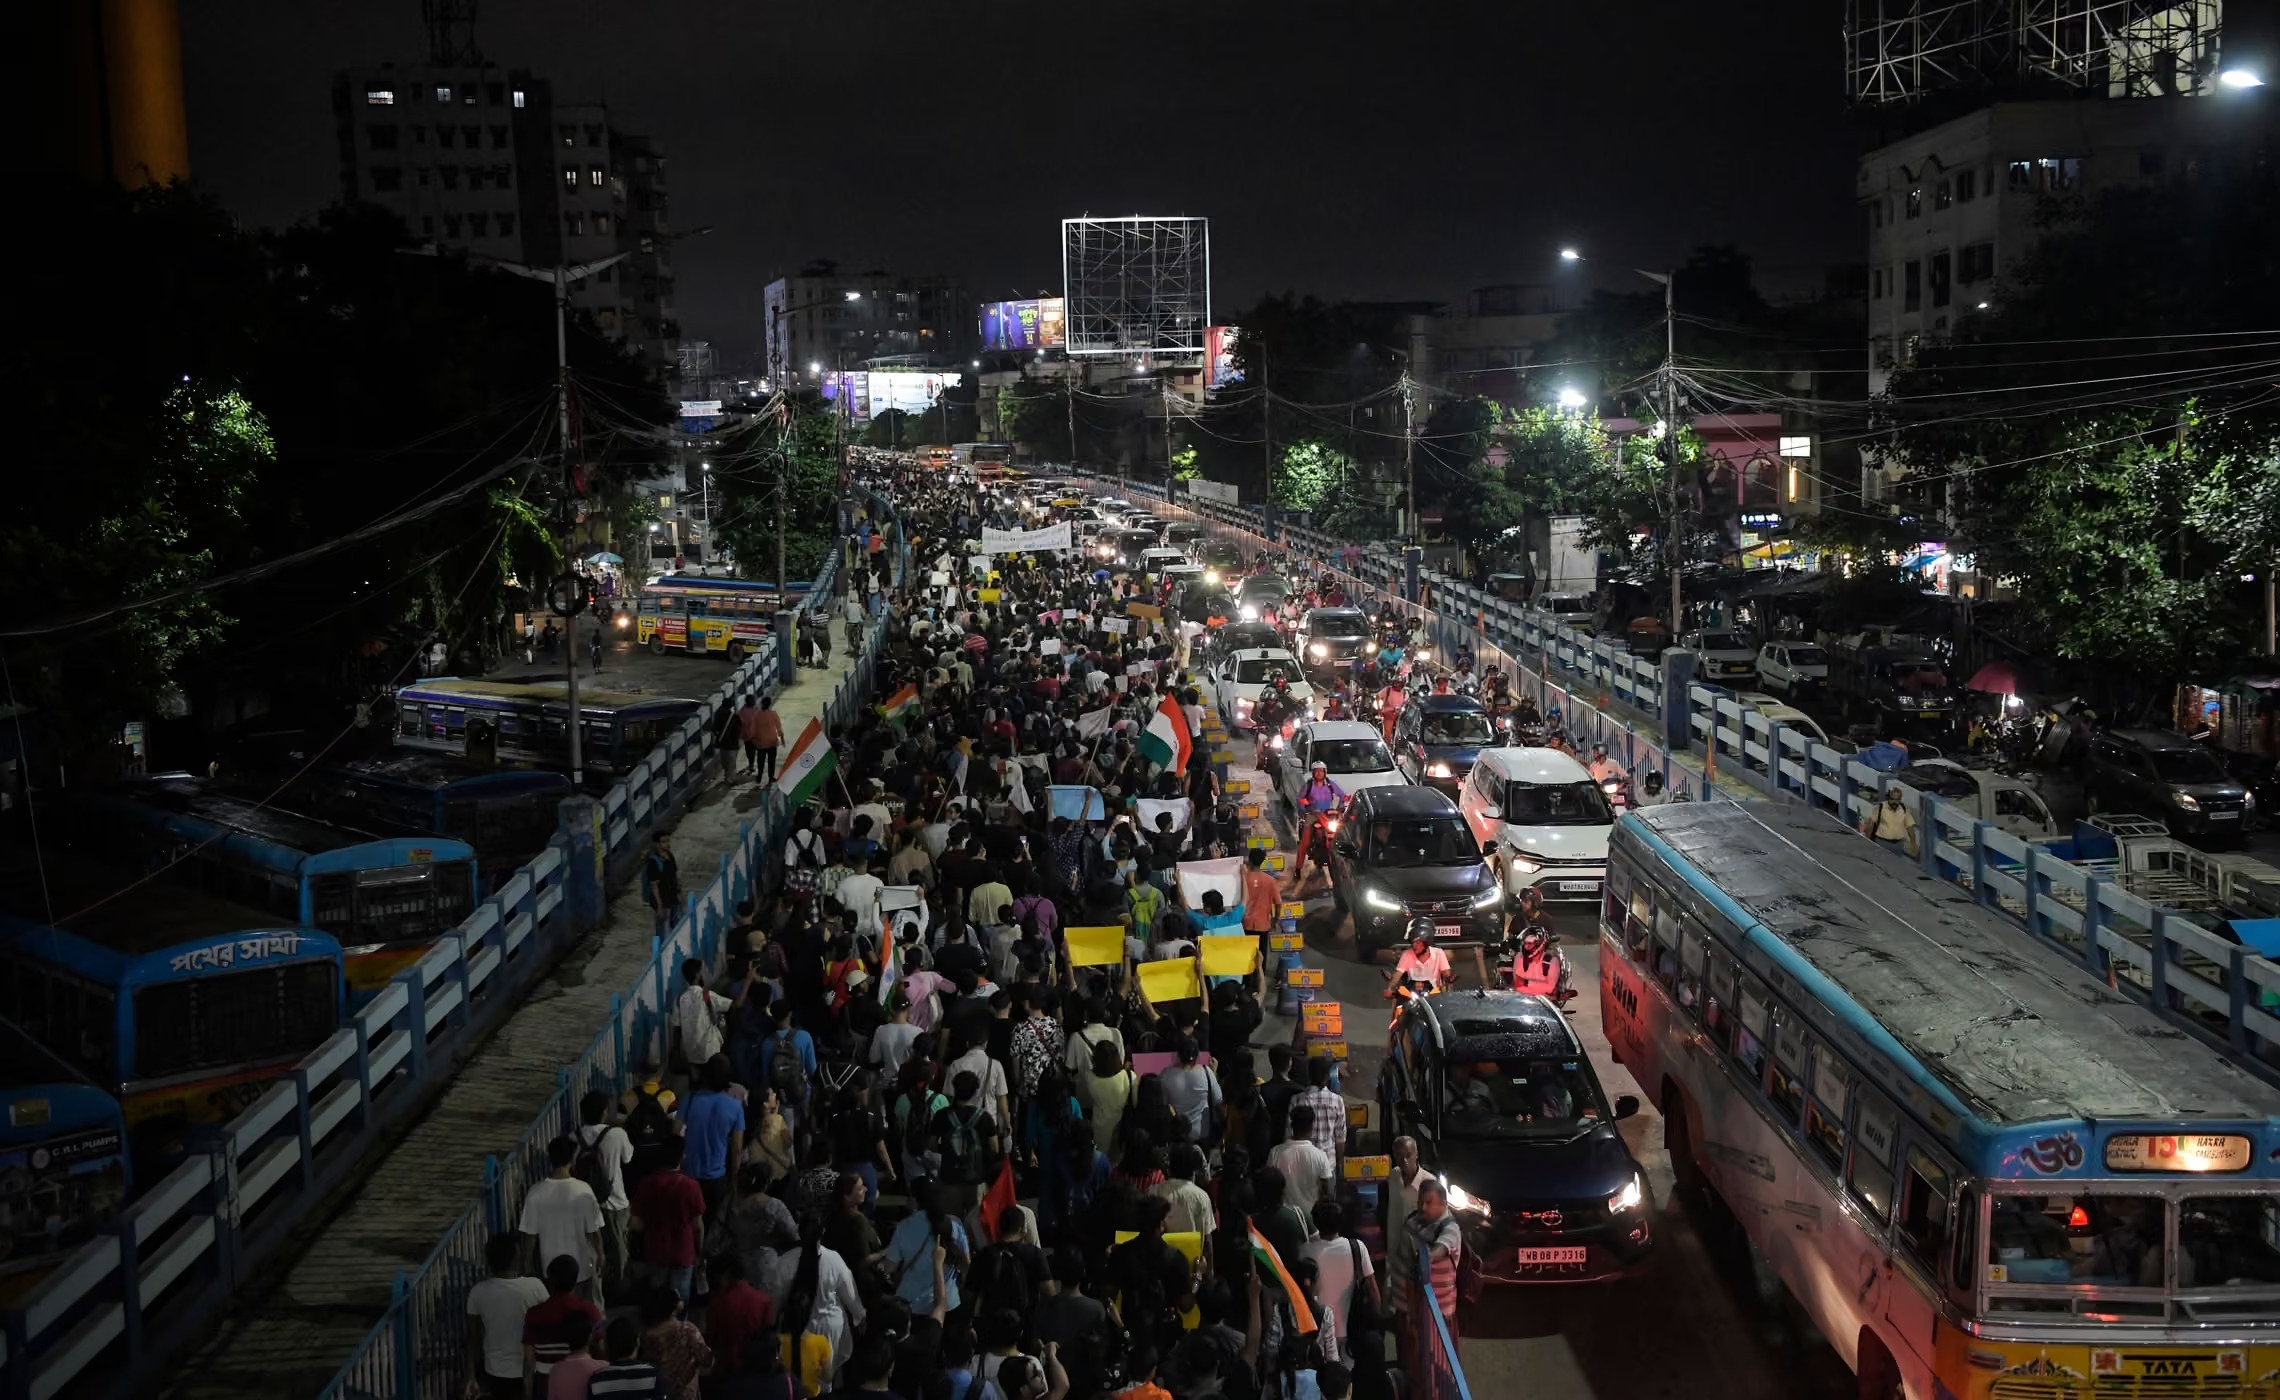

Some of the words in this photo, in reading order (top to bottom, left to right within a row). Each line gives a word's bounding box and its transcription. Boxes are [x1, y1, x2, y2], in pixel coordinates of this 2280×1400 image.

[169, 942, 235, 972] পথের
[238, 930, 300, 960] সাথী
[82, 1135, 119, 1149] PUMPS
[1526, 1250, 1537, 1260] WB
[1553, 1250, 1559, 1260] P
[1562, 1250, 1585, 1260] 3316
[2143, 1361, 2196, 1374] TATA
